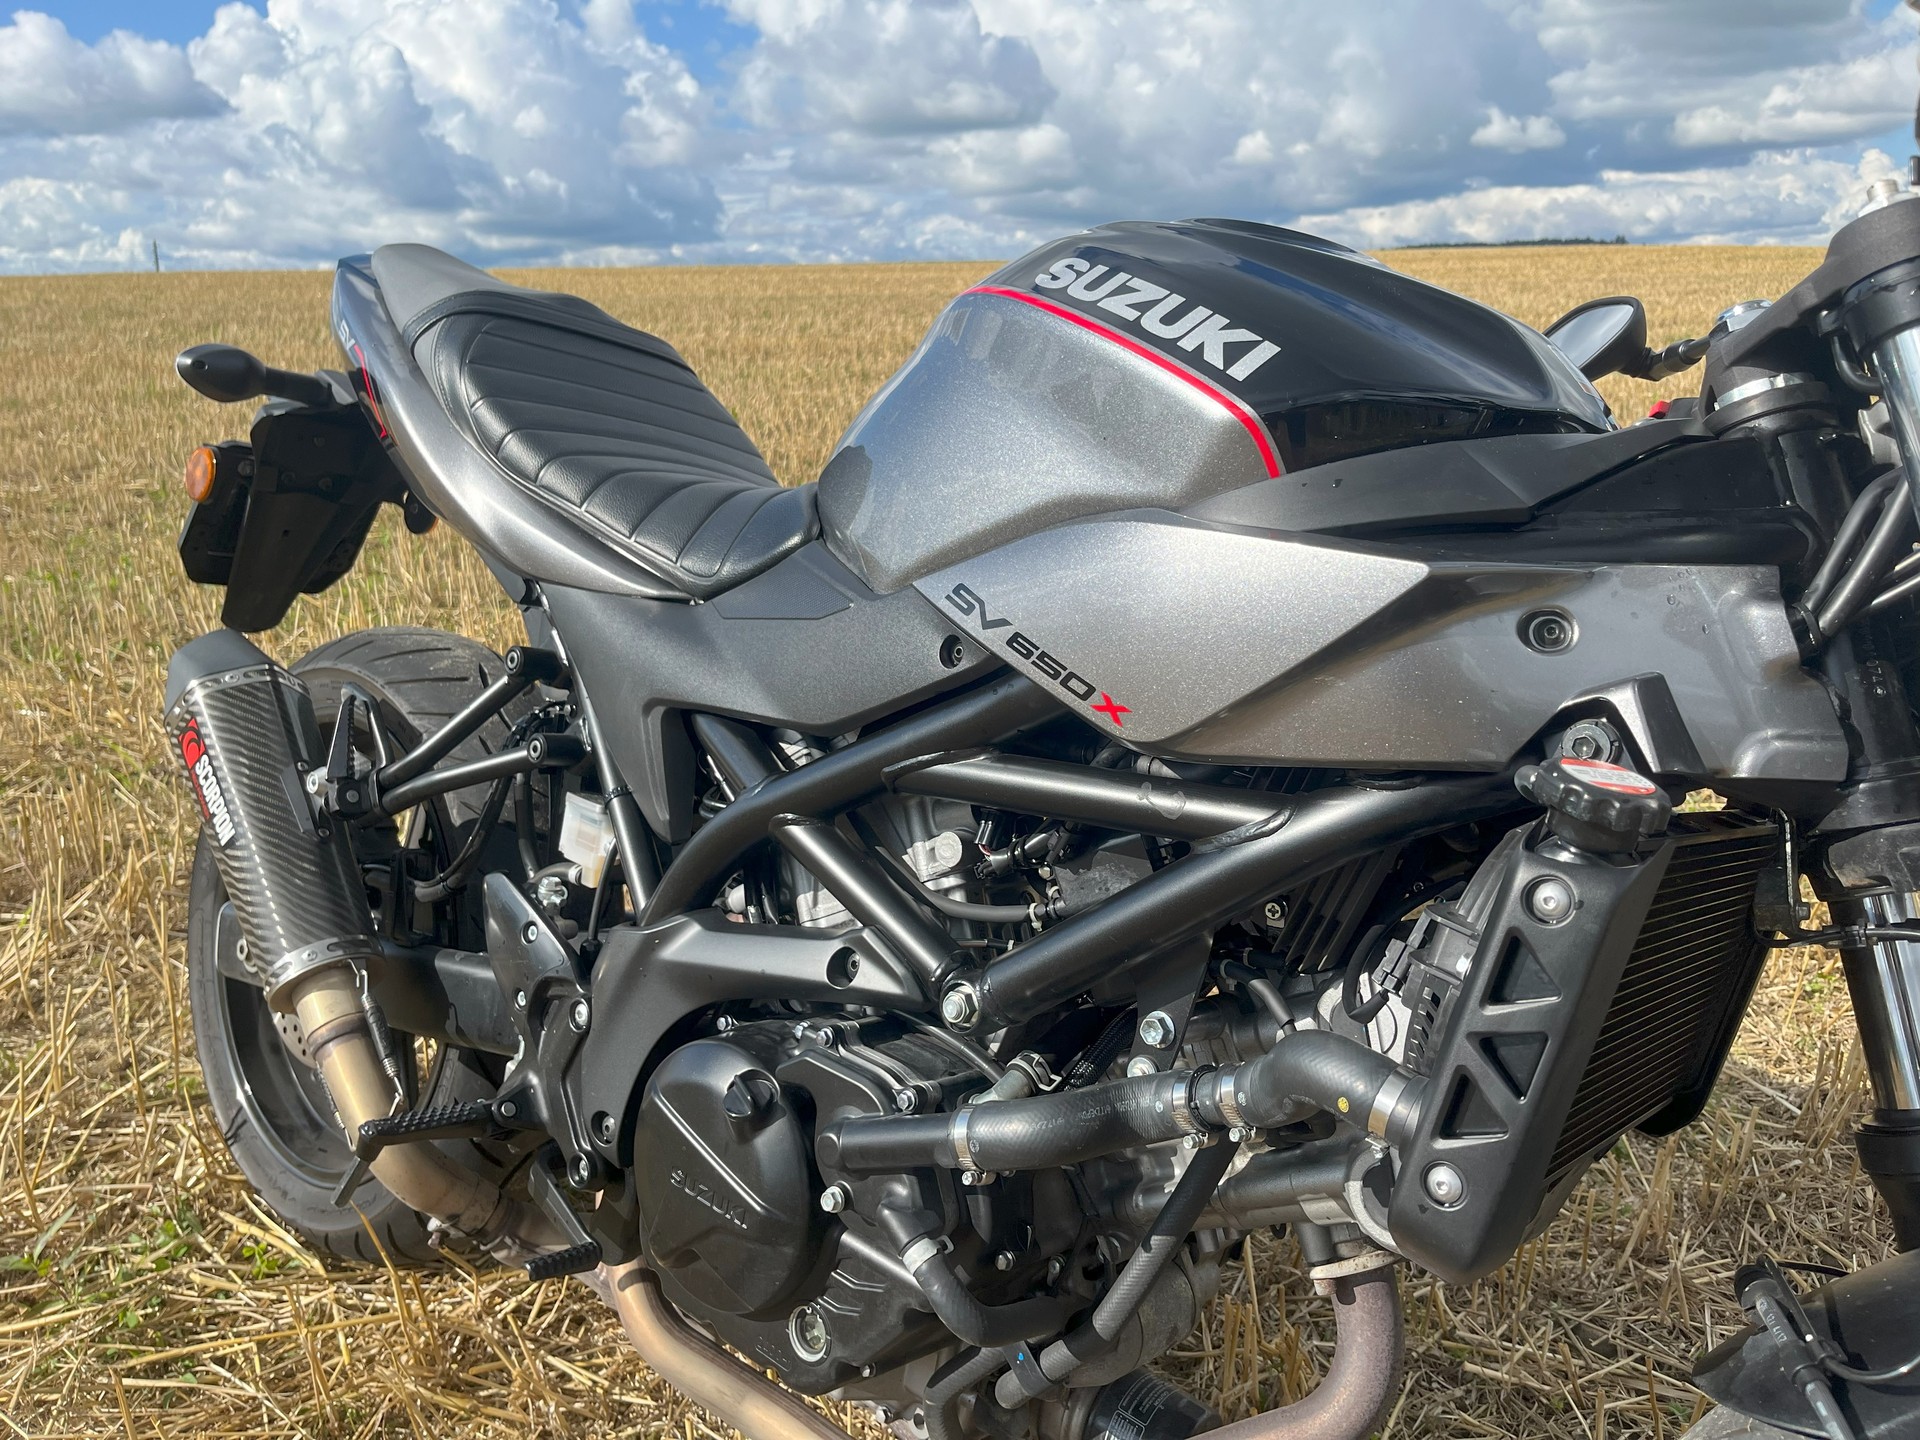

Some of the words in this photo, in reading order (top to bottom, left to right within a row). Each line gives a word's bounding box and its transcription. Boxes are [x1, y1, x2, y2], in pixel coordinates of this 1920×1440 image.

[1035, 257, 1282, 382] SUZUKI
[195, 754, 236, 847] SCORPION
[670, 1166, 748, 1230] SUZUKI
